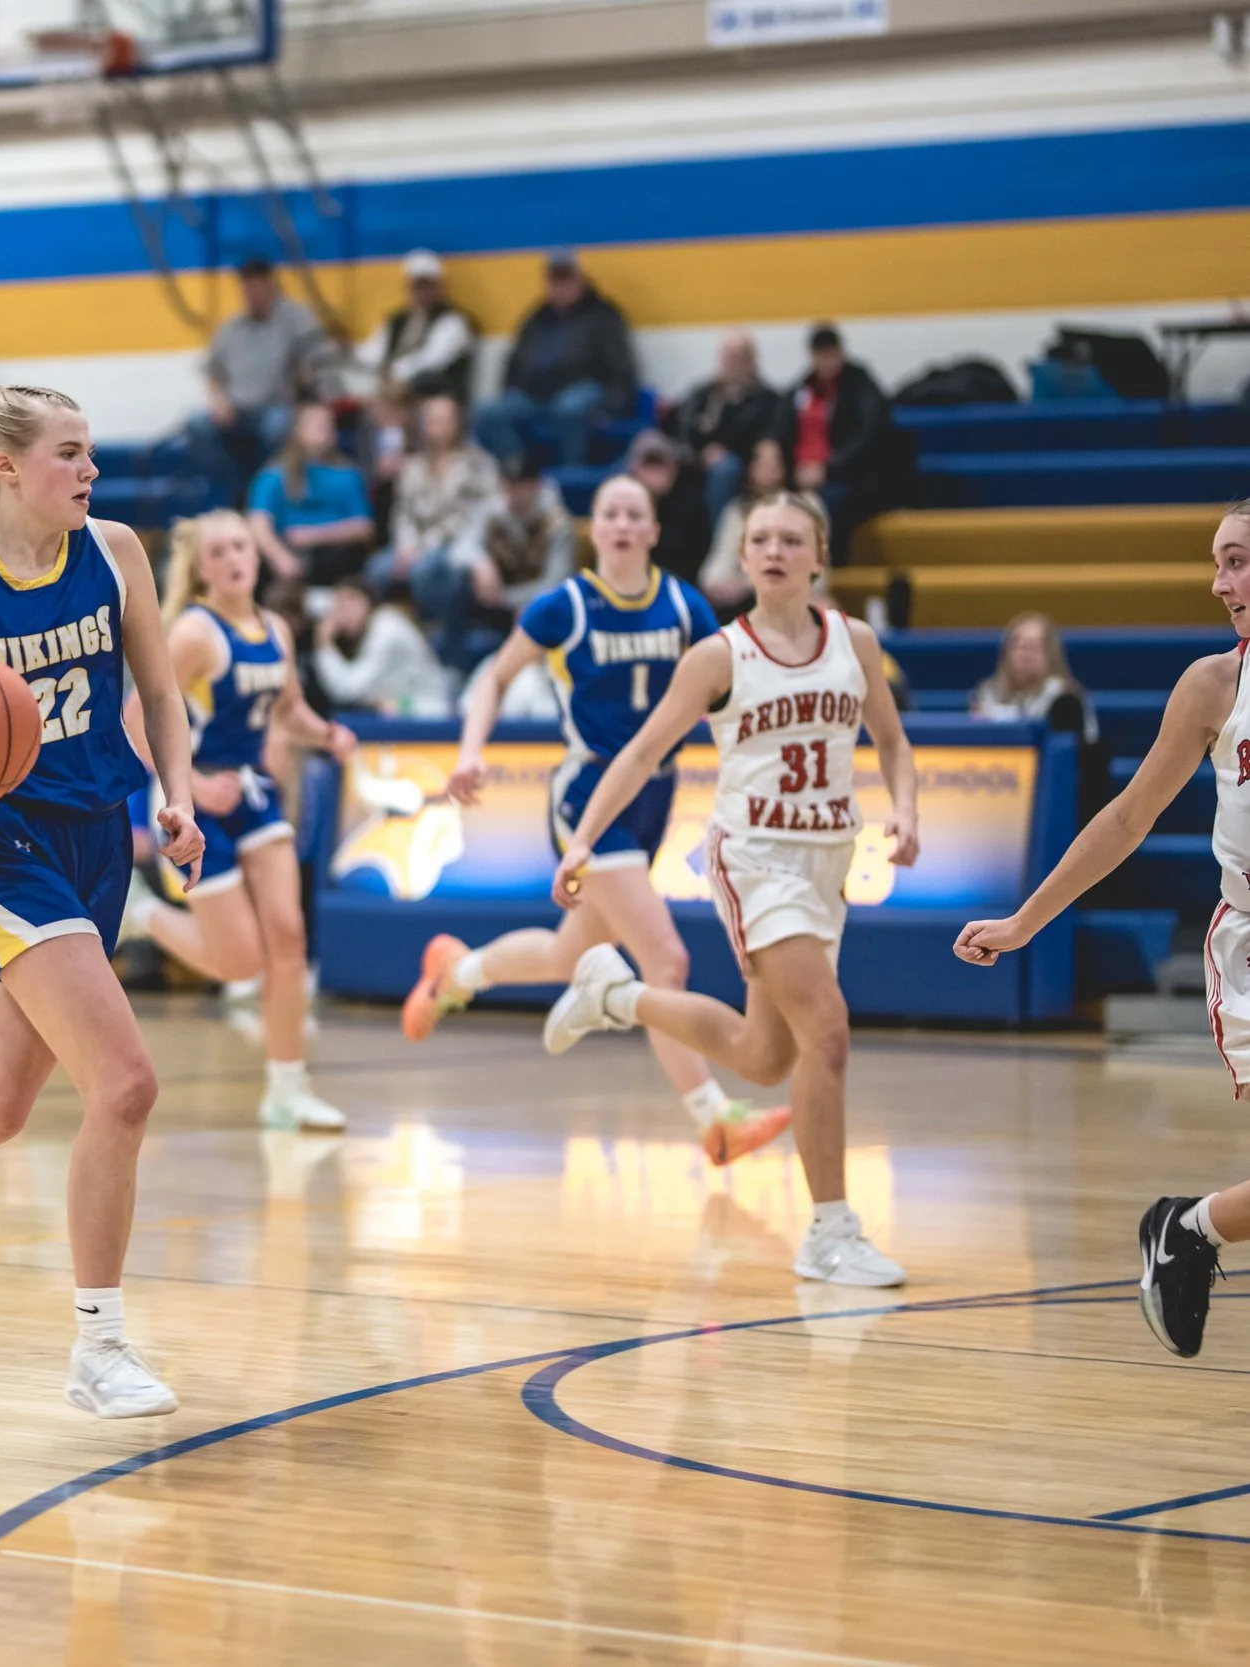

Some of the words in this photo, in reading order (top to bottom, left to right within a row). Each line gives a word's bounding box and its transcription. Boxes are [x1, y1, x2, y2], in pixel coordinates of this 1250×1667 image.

[27, 666, 92, 745] 22
[630, 663, 650, 711] 1
[779, 738, 830, 795] 31
